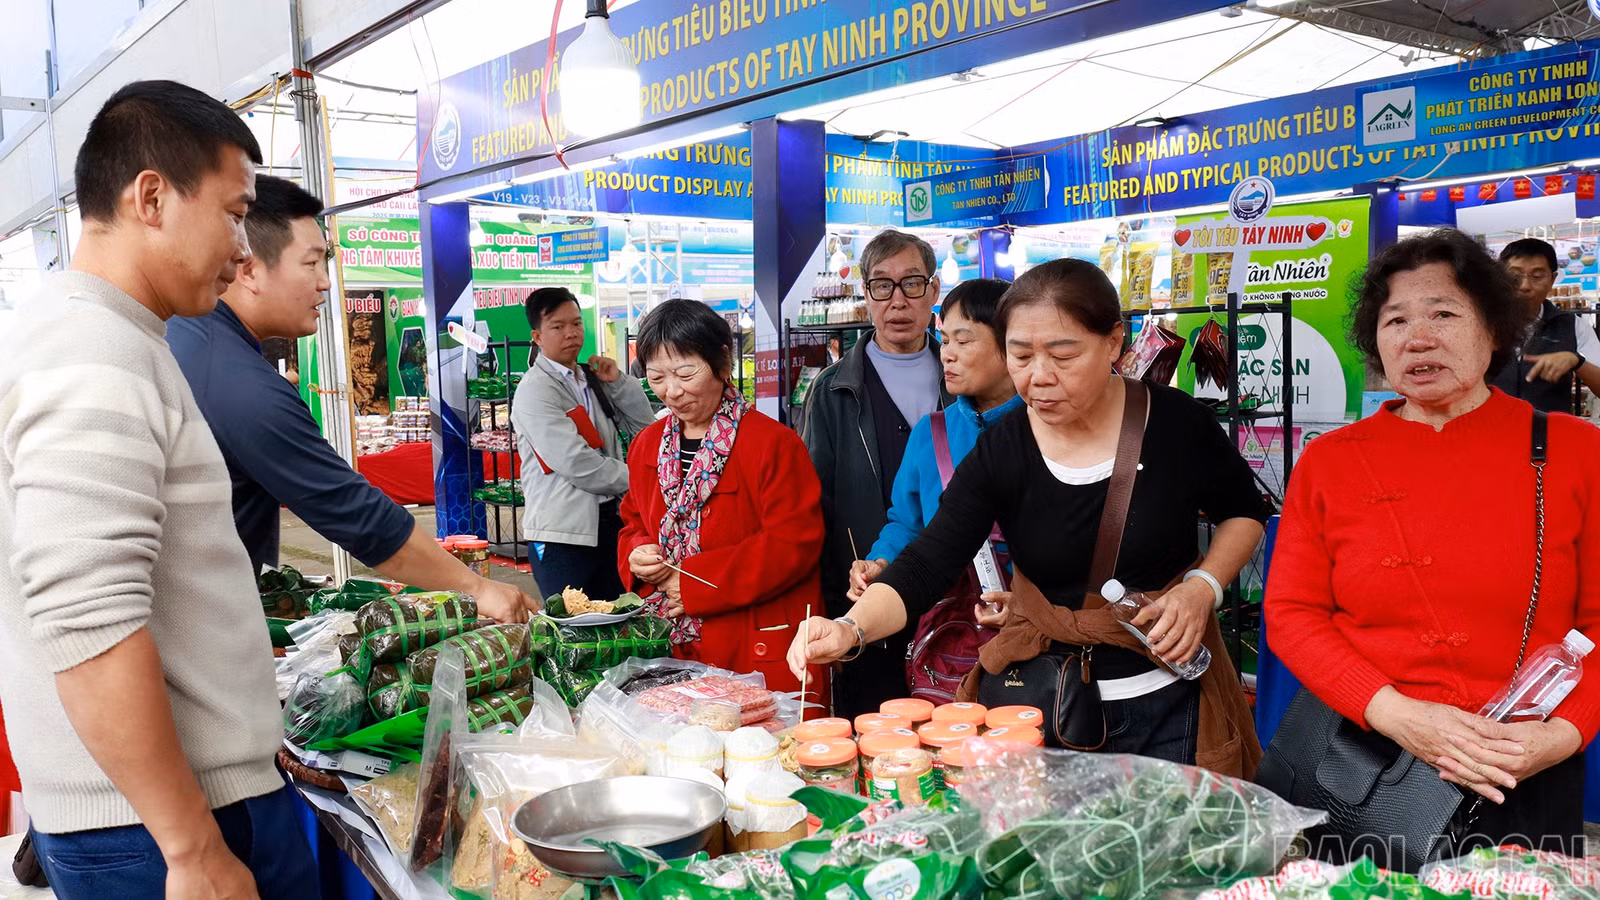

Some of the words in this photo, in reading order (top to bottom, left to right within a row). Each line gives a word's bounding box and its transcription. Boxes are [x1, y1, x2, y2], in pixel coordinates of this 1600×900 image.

[503, 68, 529, 109] SẢN
[672, 3, 715, 51] TIÊU
[472, 121, 536, 164] FEATURED
[639, 57, 740, 120] PRODUCTS
[744, 47, 772, 89] OF
[776, 34, 817, 80] TAY
[822, 13, 887, 69] NINH
[1469, 72, 1514, 92] CÔNG
[1518, 68, 1538, 84] TY
[1542, 60, 1588, 81] TNHH
[1426, 98, 1464, 119] PHÁT
[1468, 90, 1513, 113] TRIỂN
[1517, 86, 1562, 106] XANH
[1566, 81, 1600, 100] LON
[1430, 126, 1456, 136] LONG
[1458, 122, 1472, 131] AN
[1474, 117, 1508, 130] GREEN
[1510, 106, 1587, 125] DEVELOPMENT
[1101, 140, 1133, 168] SẢN
[1135, 130, 1185, 162] PHẨM
[1187, 125, 1223, 158] ĐẶC
[1225, 117, 1291, 148] TRƯNG
[1293, 104, 1338, 136] TIÊU
[685, 142, 752, 166] TRƯNG
[584, 169, 670, 193] PRODUCT
[674, 176, 744, 197] DISPLAY
[841, 187, 879, 205] NINH
[935, 181, 956, 196] CÔNG
[957, 180, 967, 192] TY
[969, 176, 992, 190] TNHH
[993, 171, 1011, 186] TÂN
[1013, 166, 1041, 183] NHIÊN
[1064, 177, 1140, 206] FEATURED
[1143, 171, 1179, 196] AND
[492, 191, 512, 202] V19
[521, 193, 540, 204] V23
[966, 198, 986, 207] NHIEN
[348, 226, 367, 240] SỞ
[371, 228, 407, 241] CÔNG
[1192, 224, 1213, 248] TÔI
[1216, 223, 1239, 247] YÊU
[1242, 223, 1266, 245] TÂY
[1268, 225, 1305, 244] NINH
[360, 245, 383, 265] TÂM
[478, 248, 498, 267] XÚC
[1248, 264, 1270, 282] ân
[1274, 260, 1326, 281] Nhiên
[356, 293, 381, 312] BIỂU
[1249, 290, 1275, 301] KHÔNG
[1303, 288, 1327, 298] NƯỚC
[1238, 332, 1257, 346] iệm
[1238, 355, 1266, 381] ẶC
[1271, 358, 1310, 376] SN
